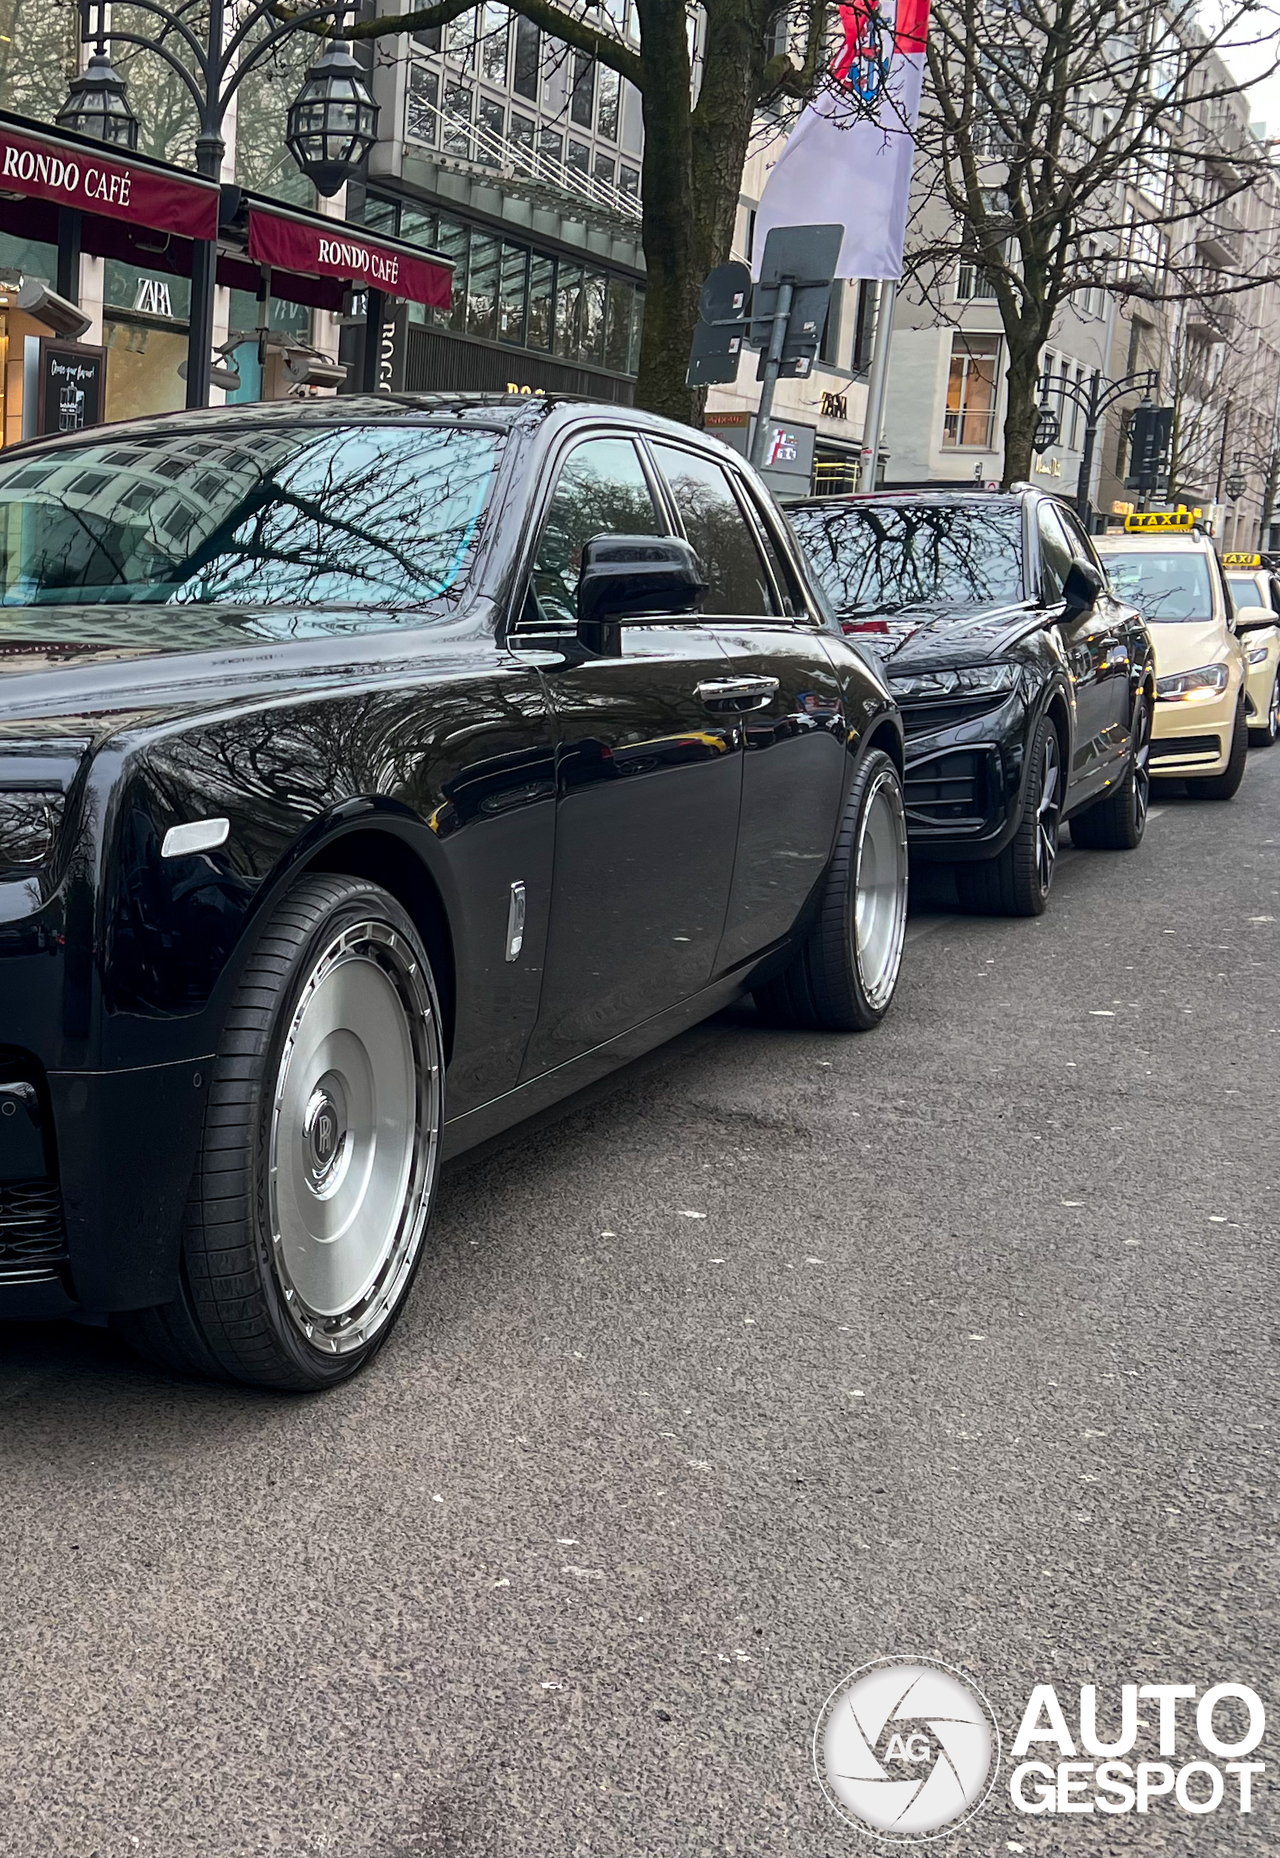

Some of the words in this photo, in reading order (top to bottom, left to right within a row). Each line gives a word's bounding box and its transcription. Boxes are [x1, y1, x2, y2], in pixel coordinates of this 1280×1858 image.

[1, 146, 80, 191] RONDO
[84, 168, 132, 206] CAFÉ
[318, 239, 370, 272] RONDO
[371, 254, 399, 285] CAFÉ
[135, 277, 173, 318] ZARA
[1136, 514, 1181, 526] TAXI
[1222, 554, 1252, 563] TAXI
